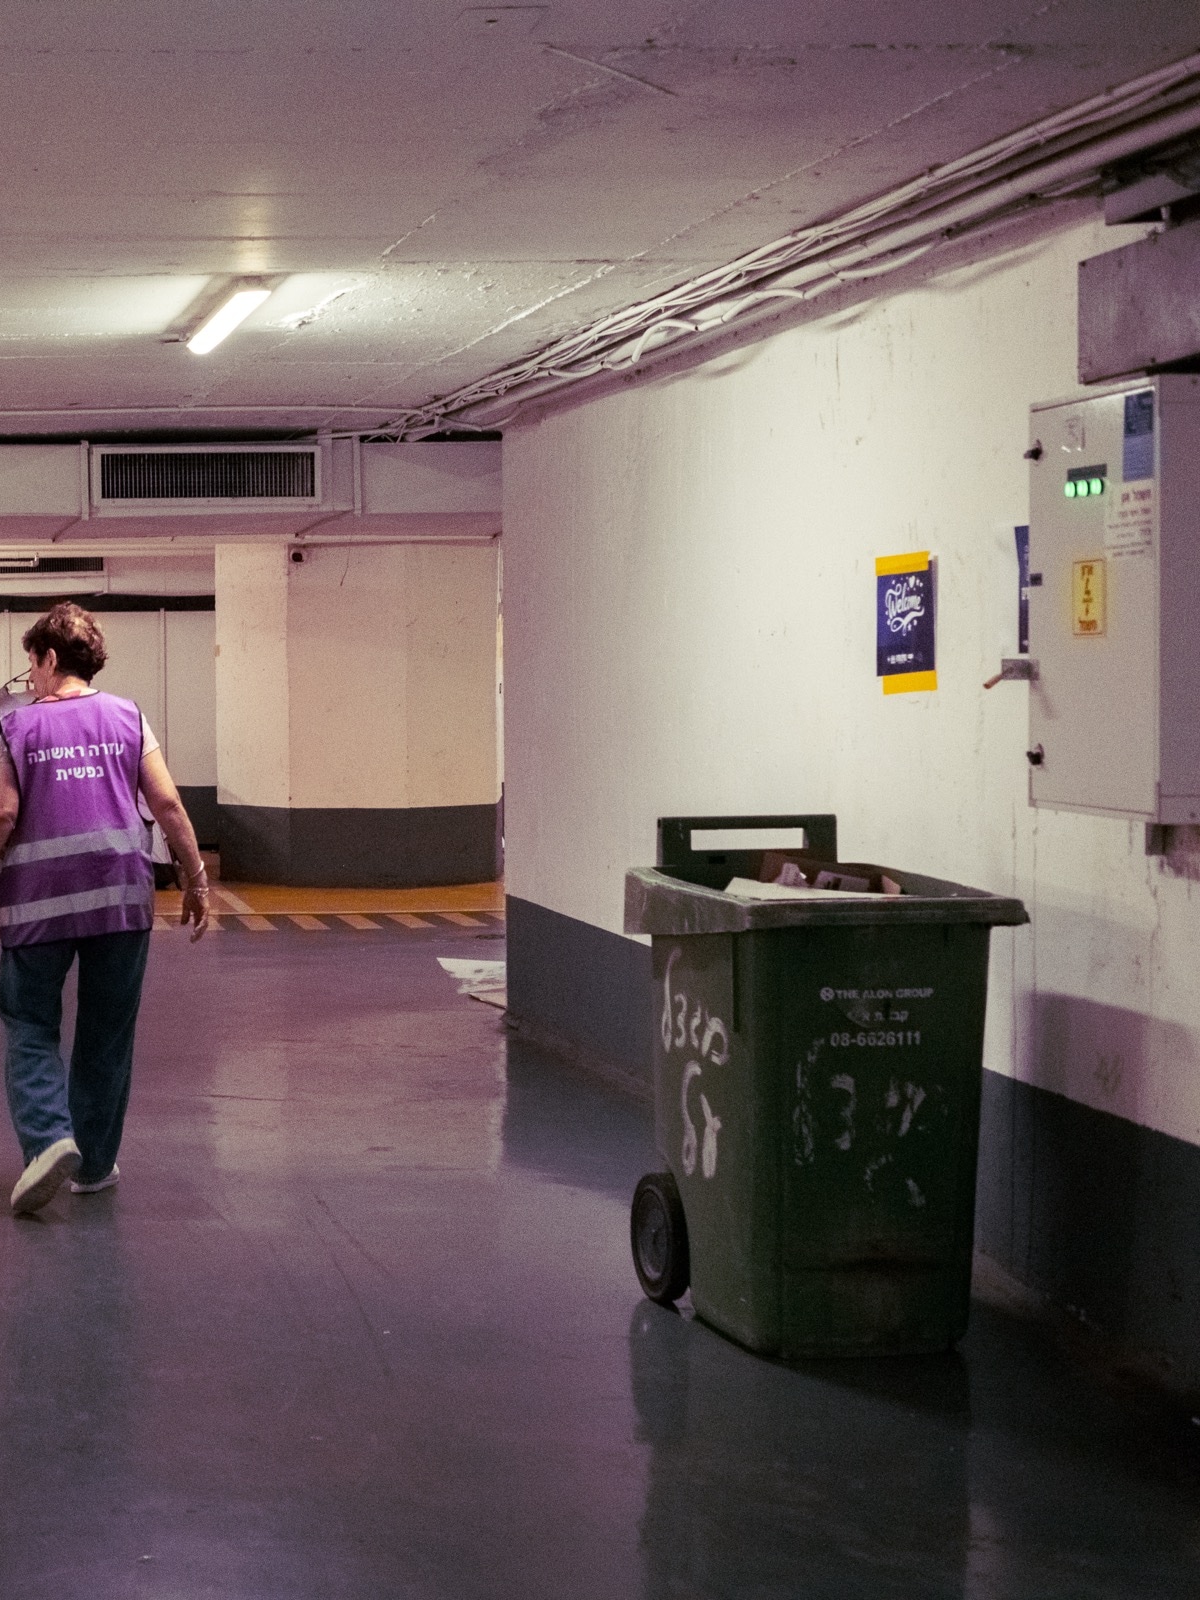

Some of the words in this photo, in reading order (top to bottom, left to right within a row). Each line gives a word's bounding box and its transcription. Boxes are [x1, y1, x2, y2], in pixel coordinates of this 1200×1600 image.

[27, 745, 85, 765] ראשונה
[88, 742, 125, 757] עזרה
[55, 765, 105, 781] נפשית
[835, 989, 860, 999] THE
[895, 987, 934, 999] GROUP
[830, 1031, 921, 1047] 08-6626111
